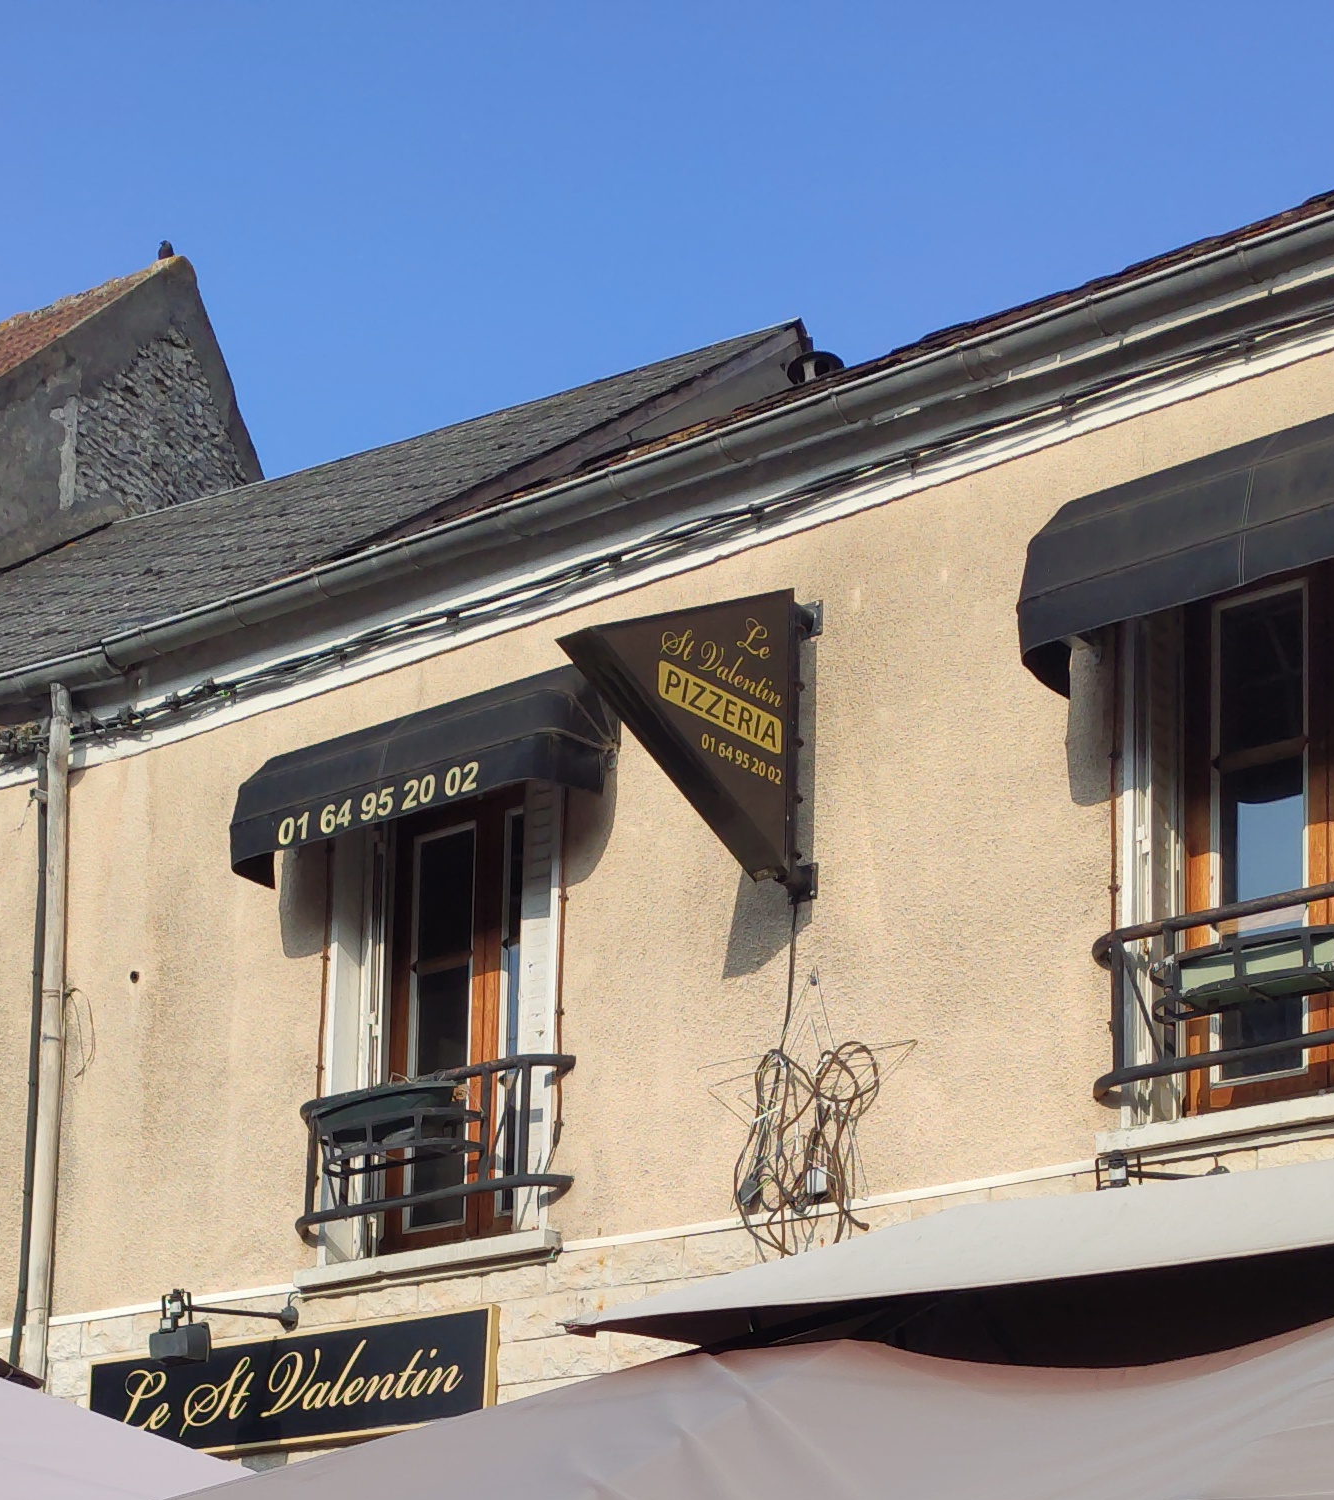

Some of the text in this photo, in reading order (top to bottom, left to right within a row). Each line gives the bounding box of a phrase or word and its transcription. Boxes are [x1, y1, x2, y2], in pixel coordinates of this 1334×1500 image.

[660, 629, 783, 708] St Valentin
[736, 617, 771, 660] Le
[664, 668, 777, 749] PIZZERIA
[701, 732, 783, 786] 01 64 95 20 02
[277, 761, 480, 845] 01 64 95 20 02
[124, 1339, 464, 1438] Le St Valentin
